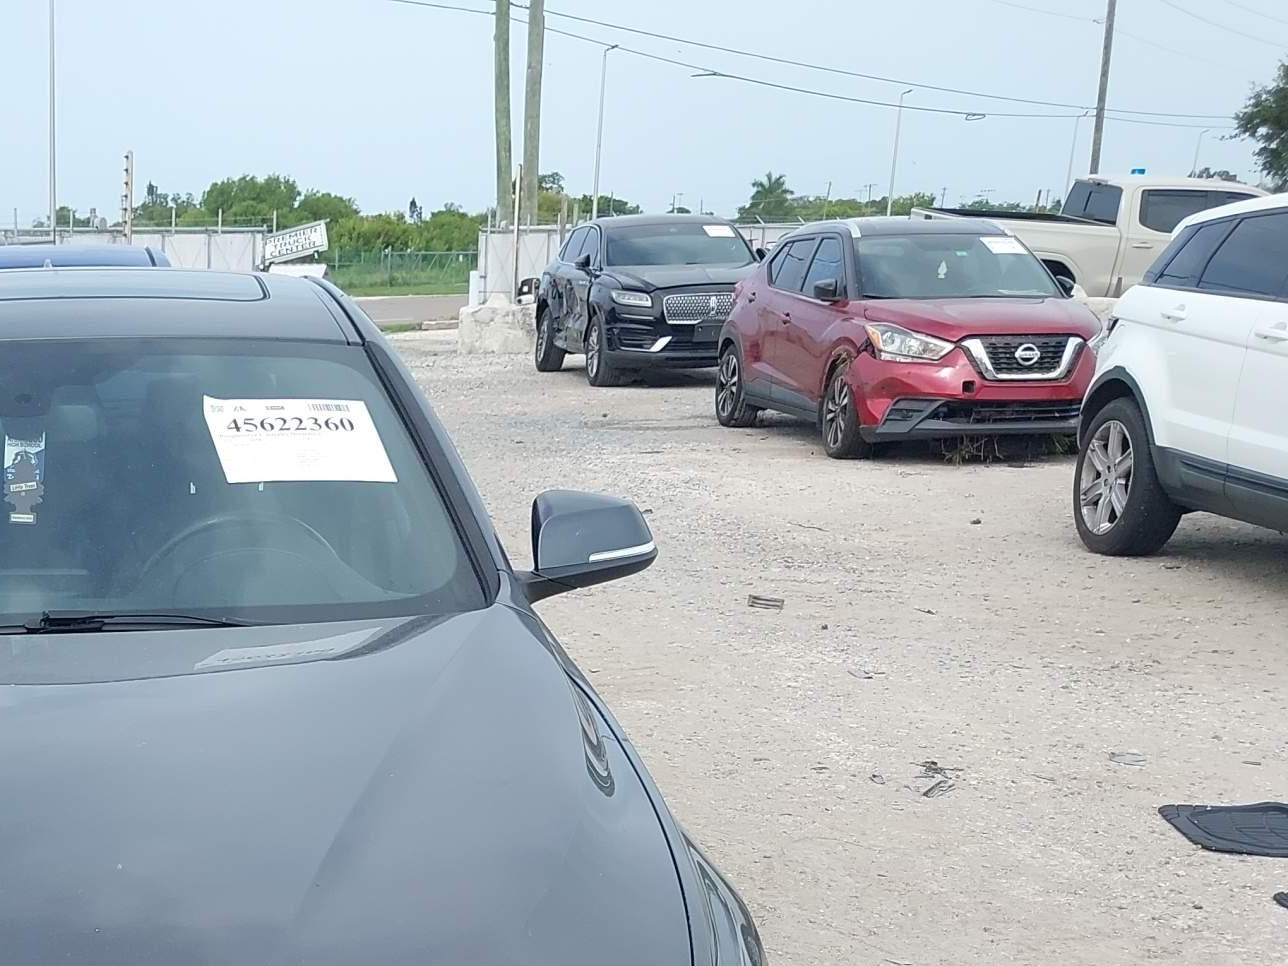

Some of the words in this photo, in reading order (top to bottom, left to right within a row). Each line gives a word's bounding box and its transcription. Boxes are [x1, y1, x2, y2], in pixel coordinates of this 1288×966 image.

[265, 227, 318, 246] PREMIER
[272, 235, 312, 249] TRUCK
[270, 241, 316, 257] CENTER
[226, 416, 355, 433] 45622360
